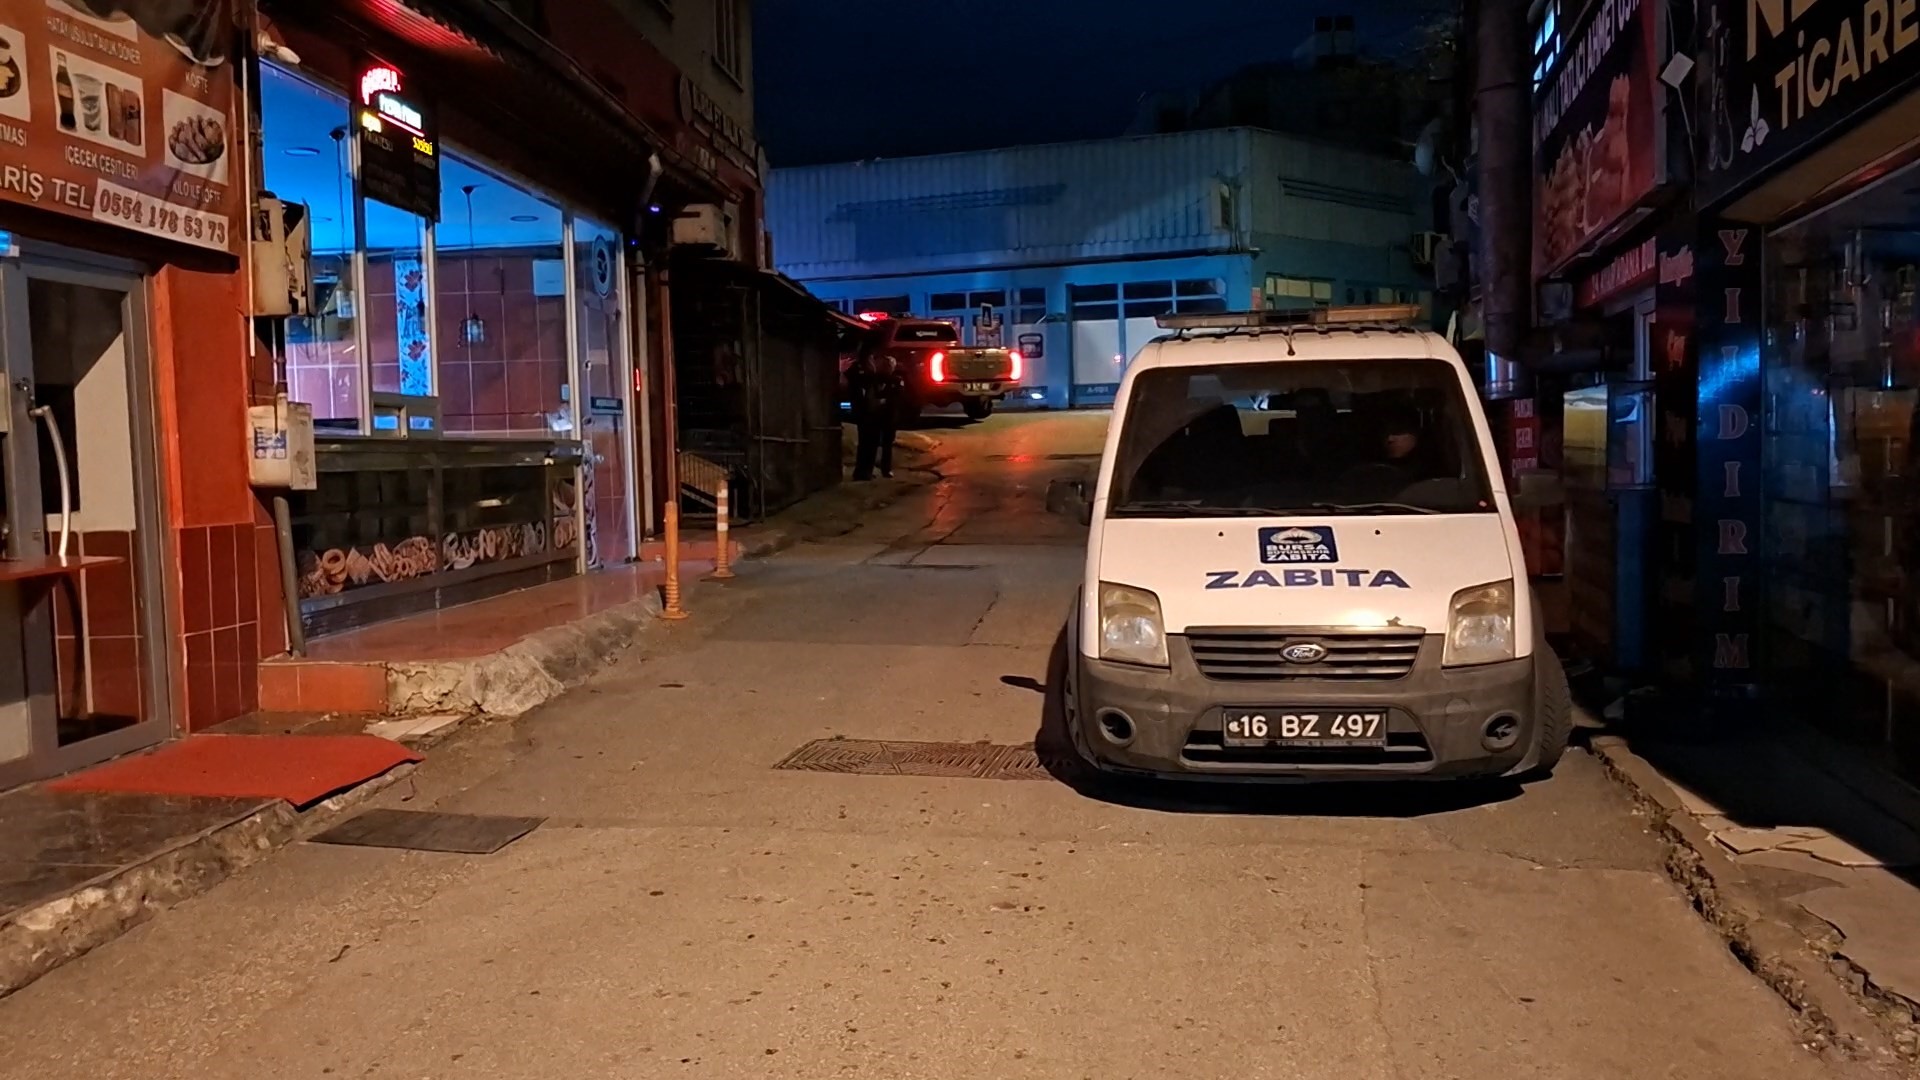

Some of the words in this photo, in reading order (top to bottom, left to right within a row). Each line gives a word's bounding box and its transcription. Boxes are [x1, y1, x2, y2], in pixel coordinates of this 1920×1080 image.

[0, 164, 44, 202] RİŞ
[51, 177, 91, 209] TEL
[99, 188, 143, 223] 0554
[149, 205, 179, 233] 178
[184, 215, 203, 239] 53
[208, 220, 225, 244] 73
[1204, 569, 1412, 589] ZABITA
[1292, 646, 1315, 658] Ford
[1240, 714, 1269, 737] 16
[1281, 714, 1320, 737] BZ
[1330, 714, 1380, 737] 497
